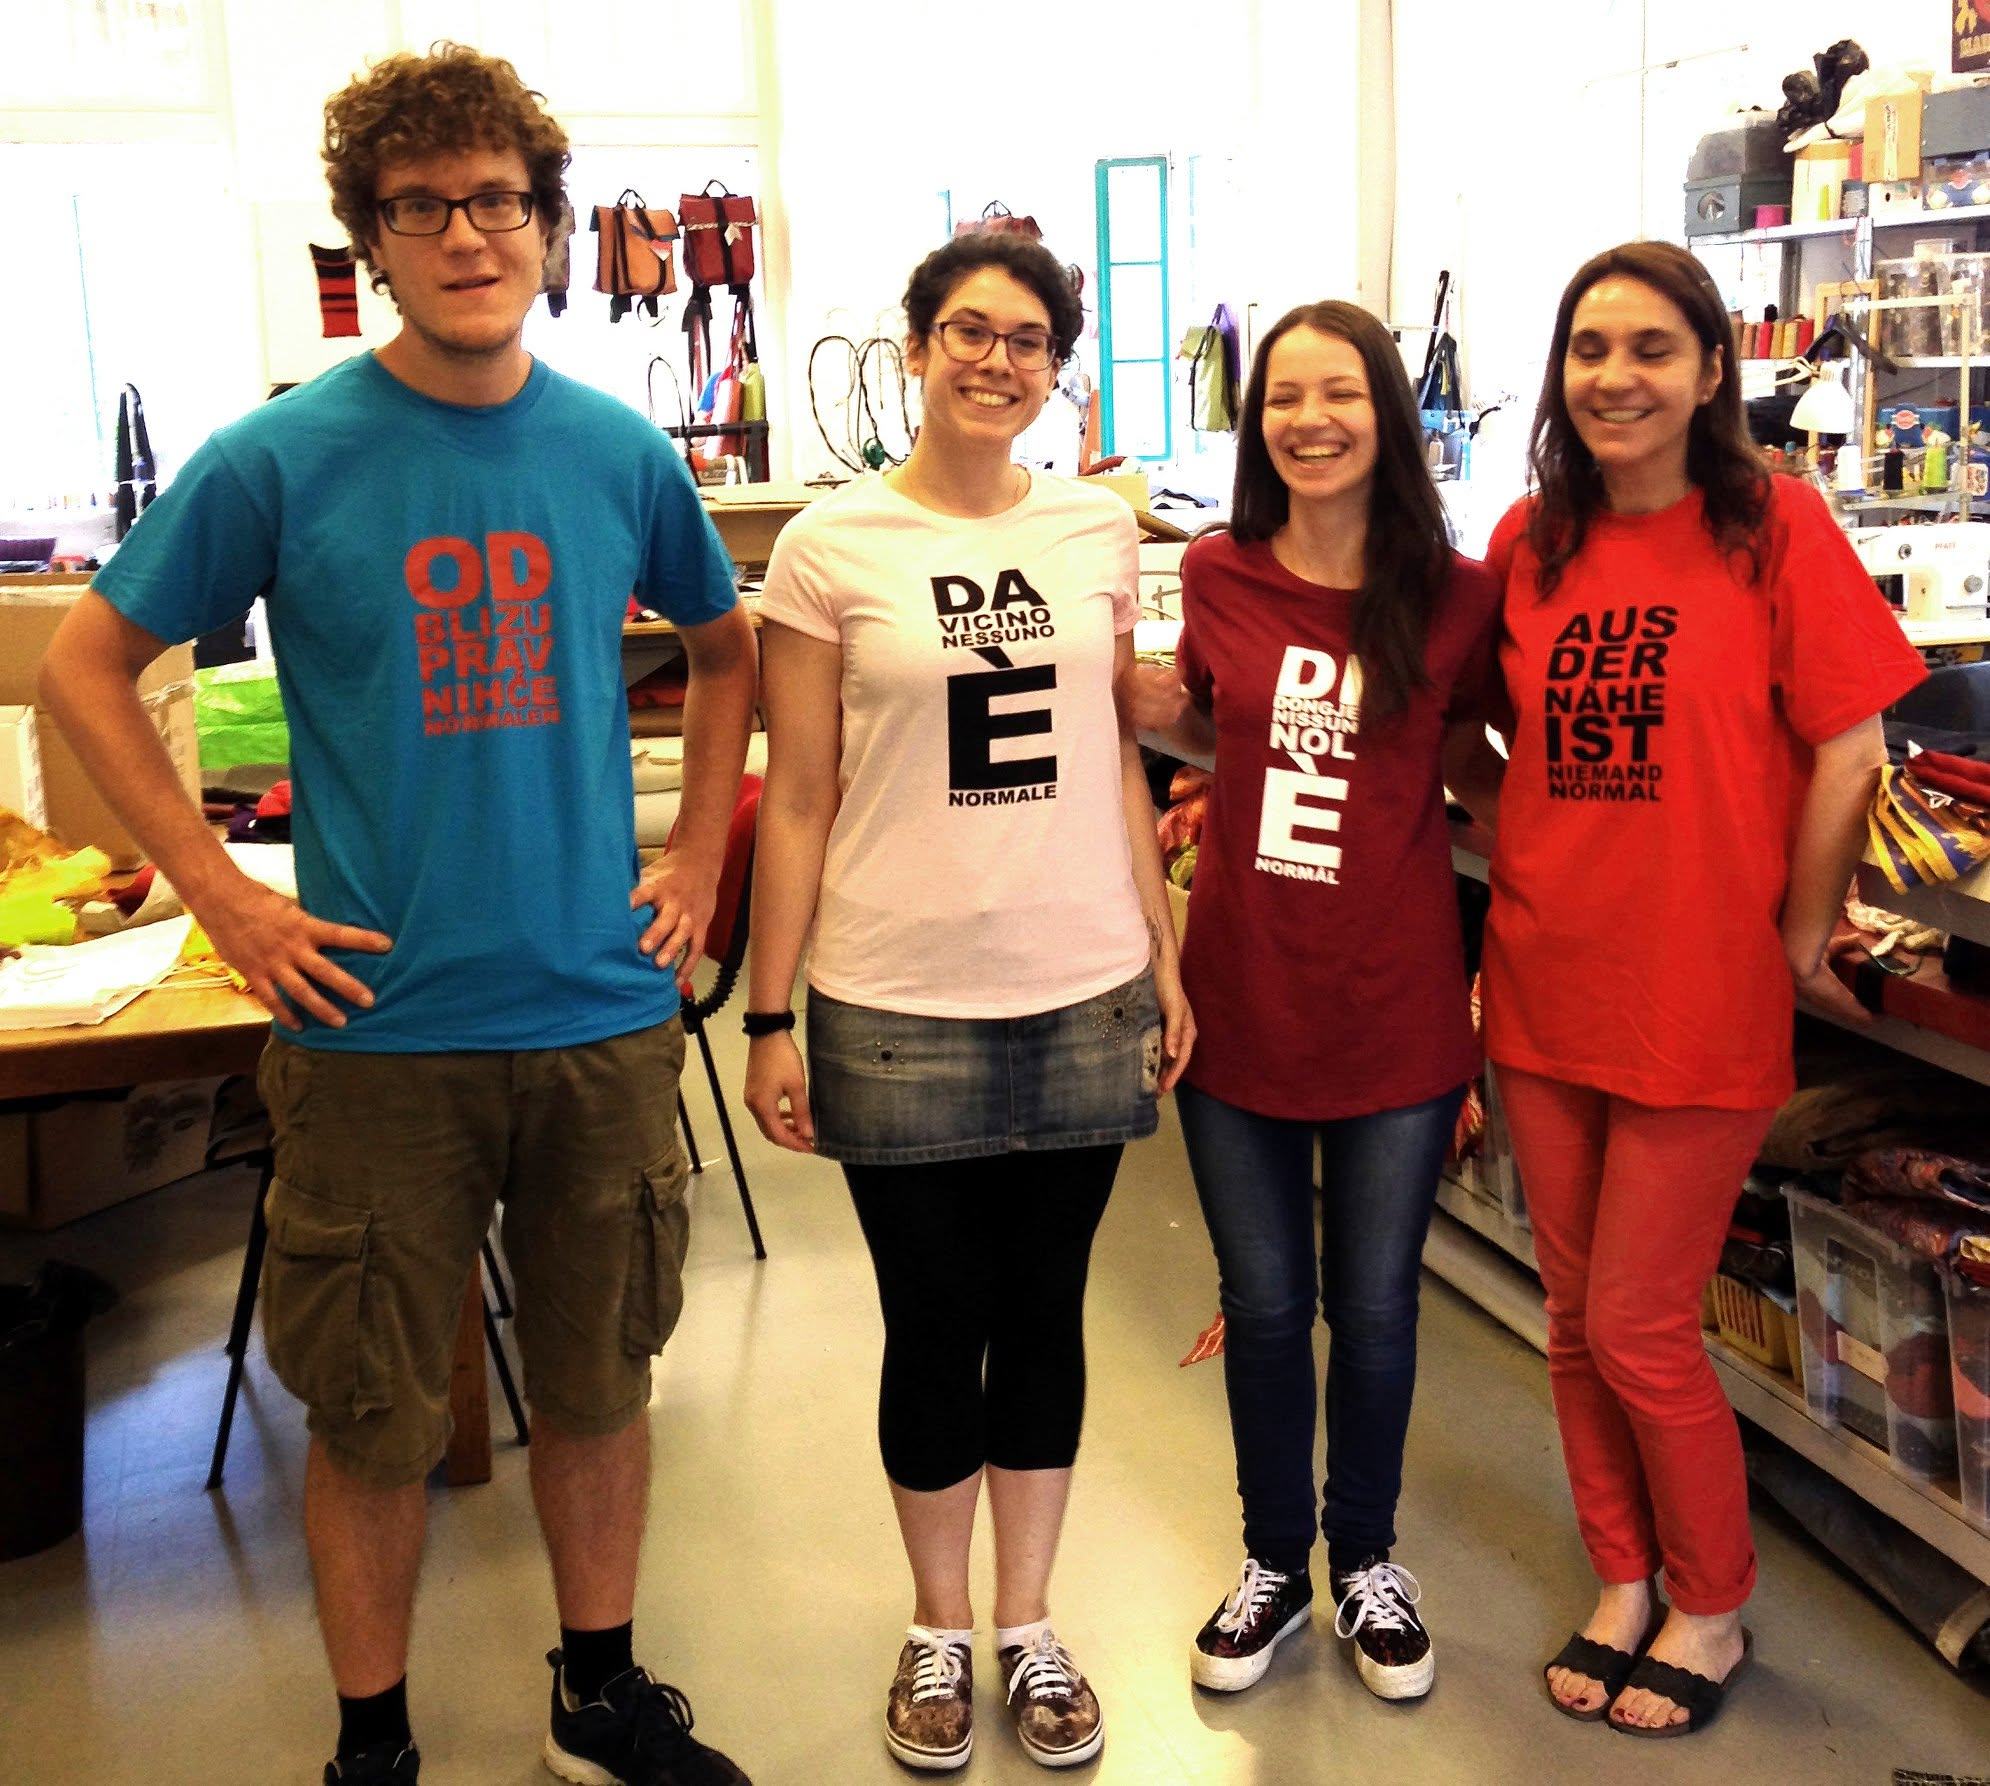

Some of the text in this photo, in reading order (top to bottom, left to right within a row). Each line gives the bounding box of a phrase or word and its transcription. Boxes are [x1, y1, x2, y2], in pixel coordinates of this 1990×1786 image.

[404, 530, 552, 609] OD
[930, 568, 1048, 616] DA
[414, 603, 551, 645] BLIZU
[938, 607, 1051, 634] VICINO
[942, 624, 1055, 649] NESSUNO
[1554, 605, 1680, 645] AUS
[418, 637, 554, 682] PRAV
[1546, 642, 1669, 681] DER
[946, 645, 1057, 791] È
[1269, 722, 1357, 761] NOL
[1546, 713, 1664, 763] IST
[1548, 764, 1662, 782] NIEMAND
[1549, 782, 1661, 802] NORMAL
[948, 784, 1058, 808] NORMALE
[1256, 750, 1349, 870] È
[1254, 856, 1340, 886] NORMAL
